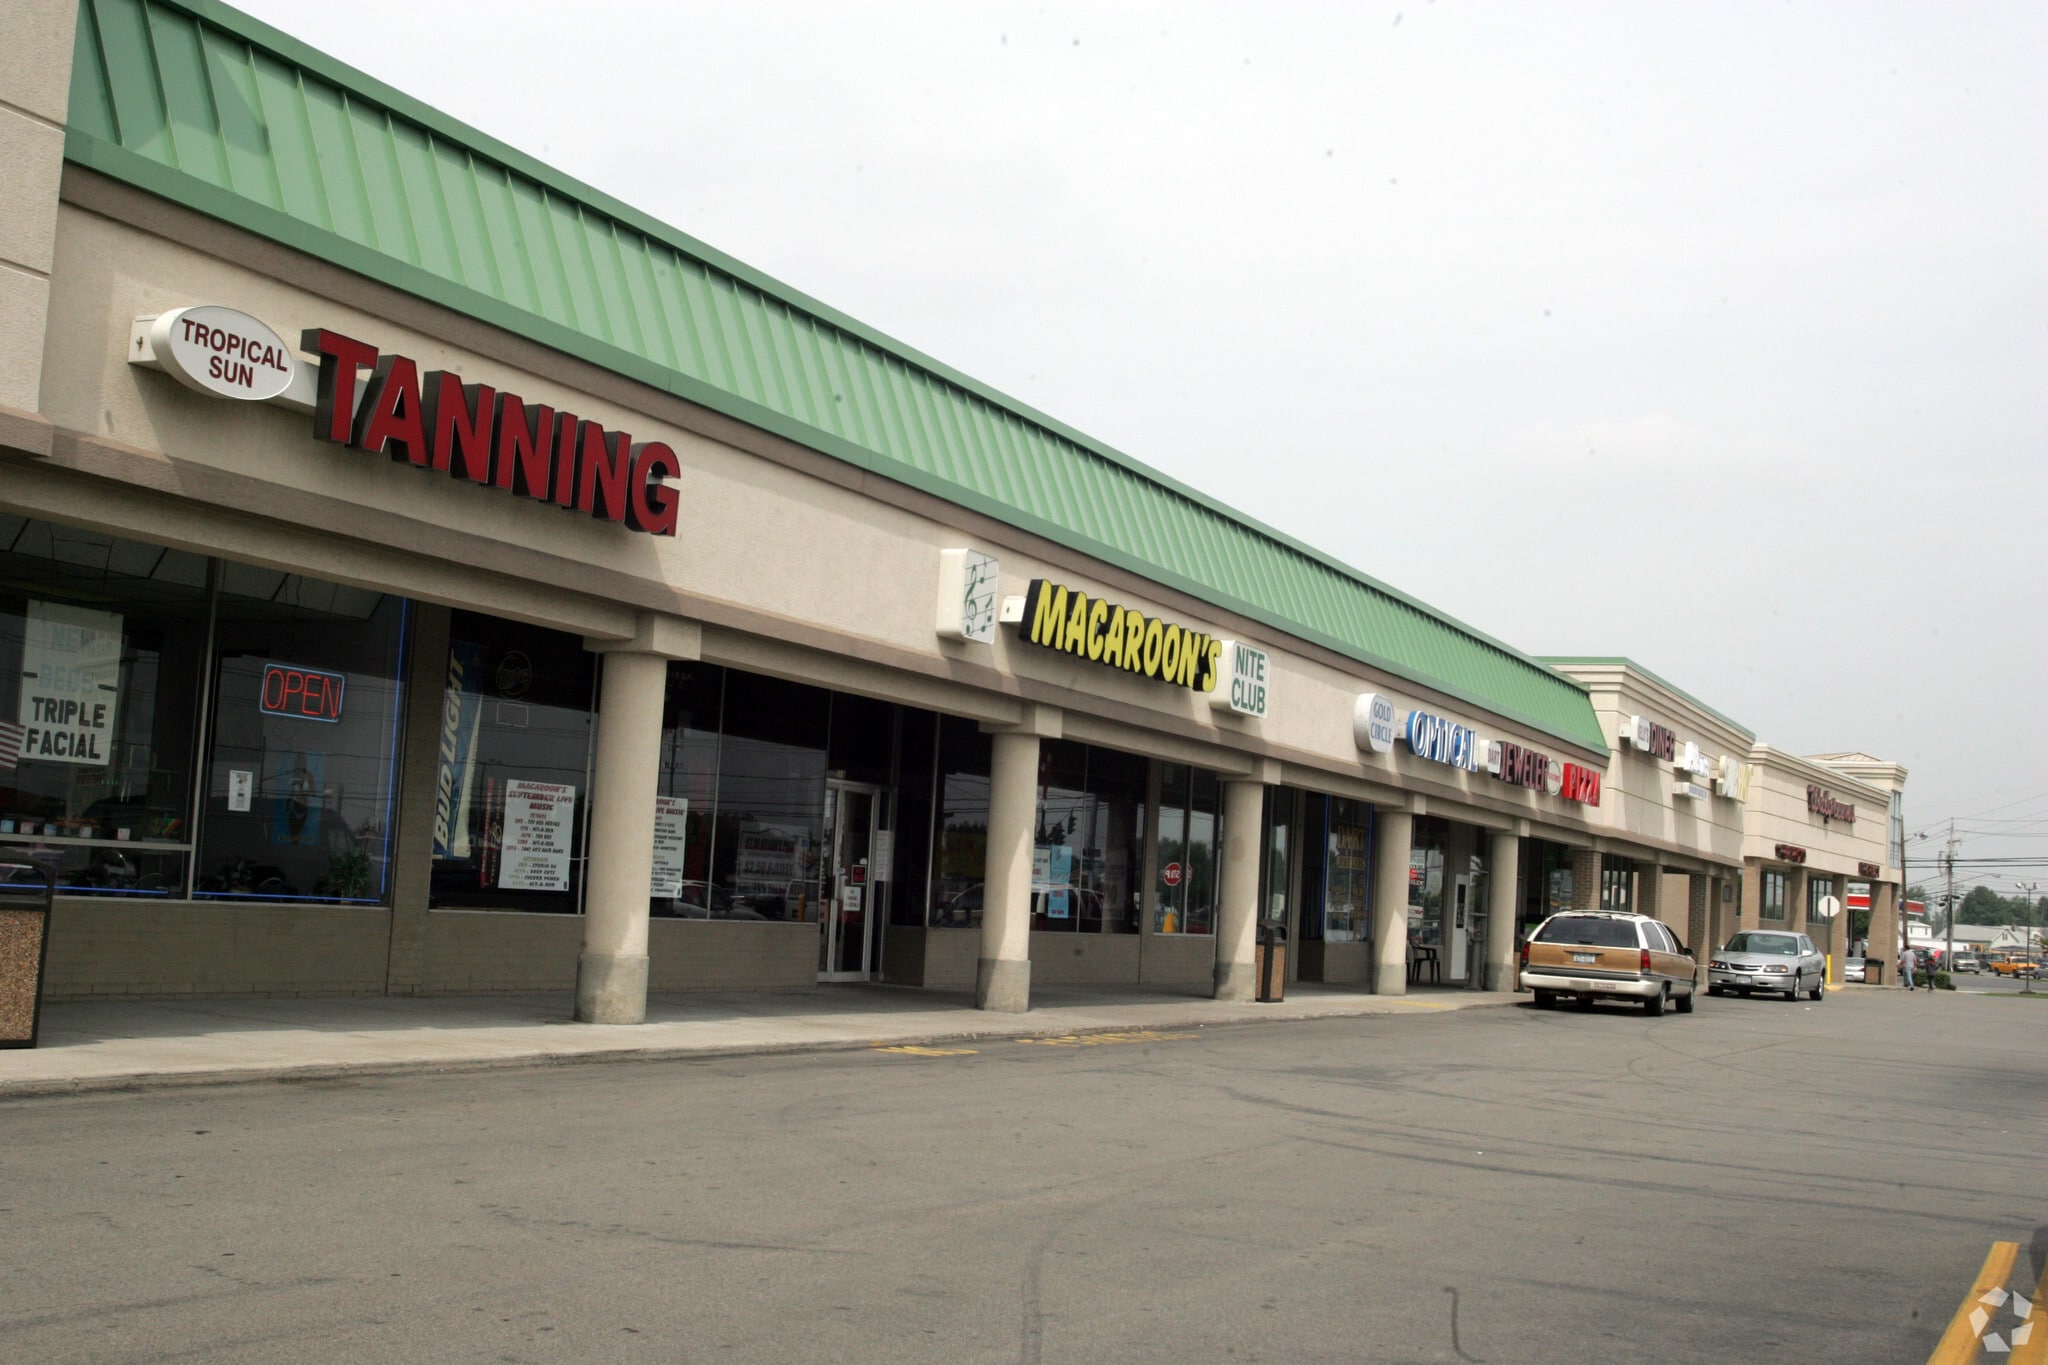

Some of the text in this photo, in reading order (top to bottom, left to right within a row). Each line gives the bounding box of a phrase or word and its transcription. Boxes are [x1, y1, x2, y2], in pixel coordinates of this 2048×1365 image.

[182, 318, 288, 372] TROPICAL
[208, 354, 254, 389] SUN
[304, 328, 681, 537] TANNING
[1023, 579, 1223, 693] MACAROON'S
[1235, 645, 1265, 682] NITE
[32, 696, 106, 729] TRIPLE
[263, 669, 341, 718] OPEN
[1231, 677, 1266, 715] CLUB
[1373, 701, 1392, 723] GOLD
[26, 728, 101, 760] FACIAL
[434, 648, 465, 850] BUD LIGHT
[1370, 722, 1392, 744] CIRCLE
[1409, 710, 1478, 773] OPTICAL
[1650, 721, 1675, 763] DINER
[508, 790, 555, 802] SEPTEMBER
[1565, 763, 1600, 808] PIZZA
[529, 802, 554, 811] MUSIC
